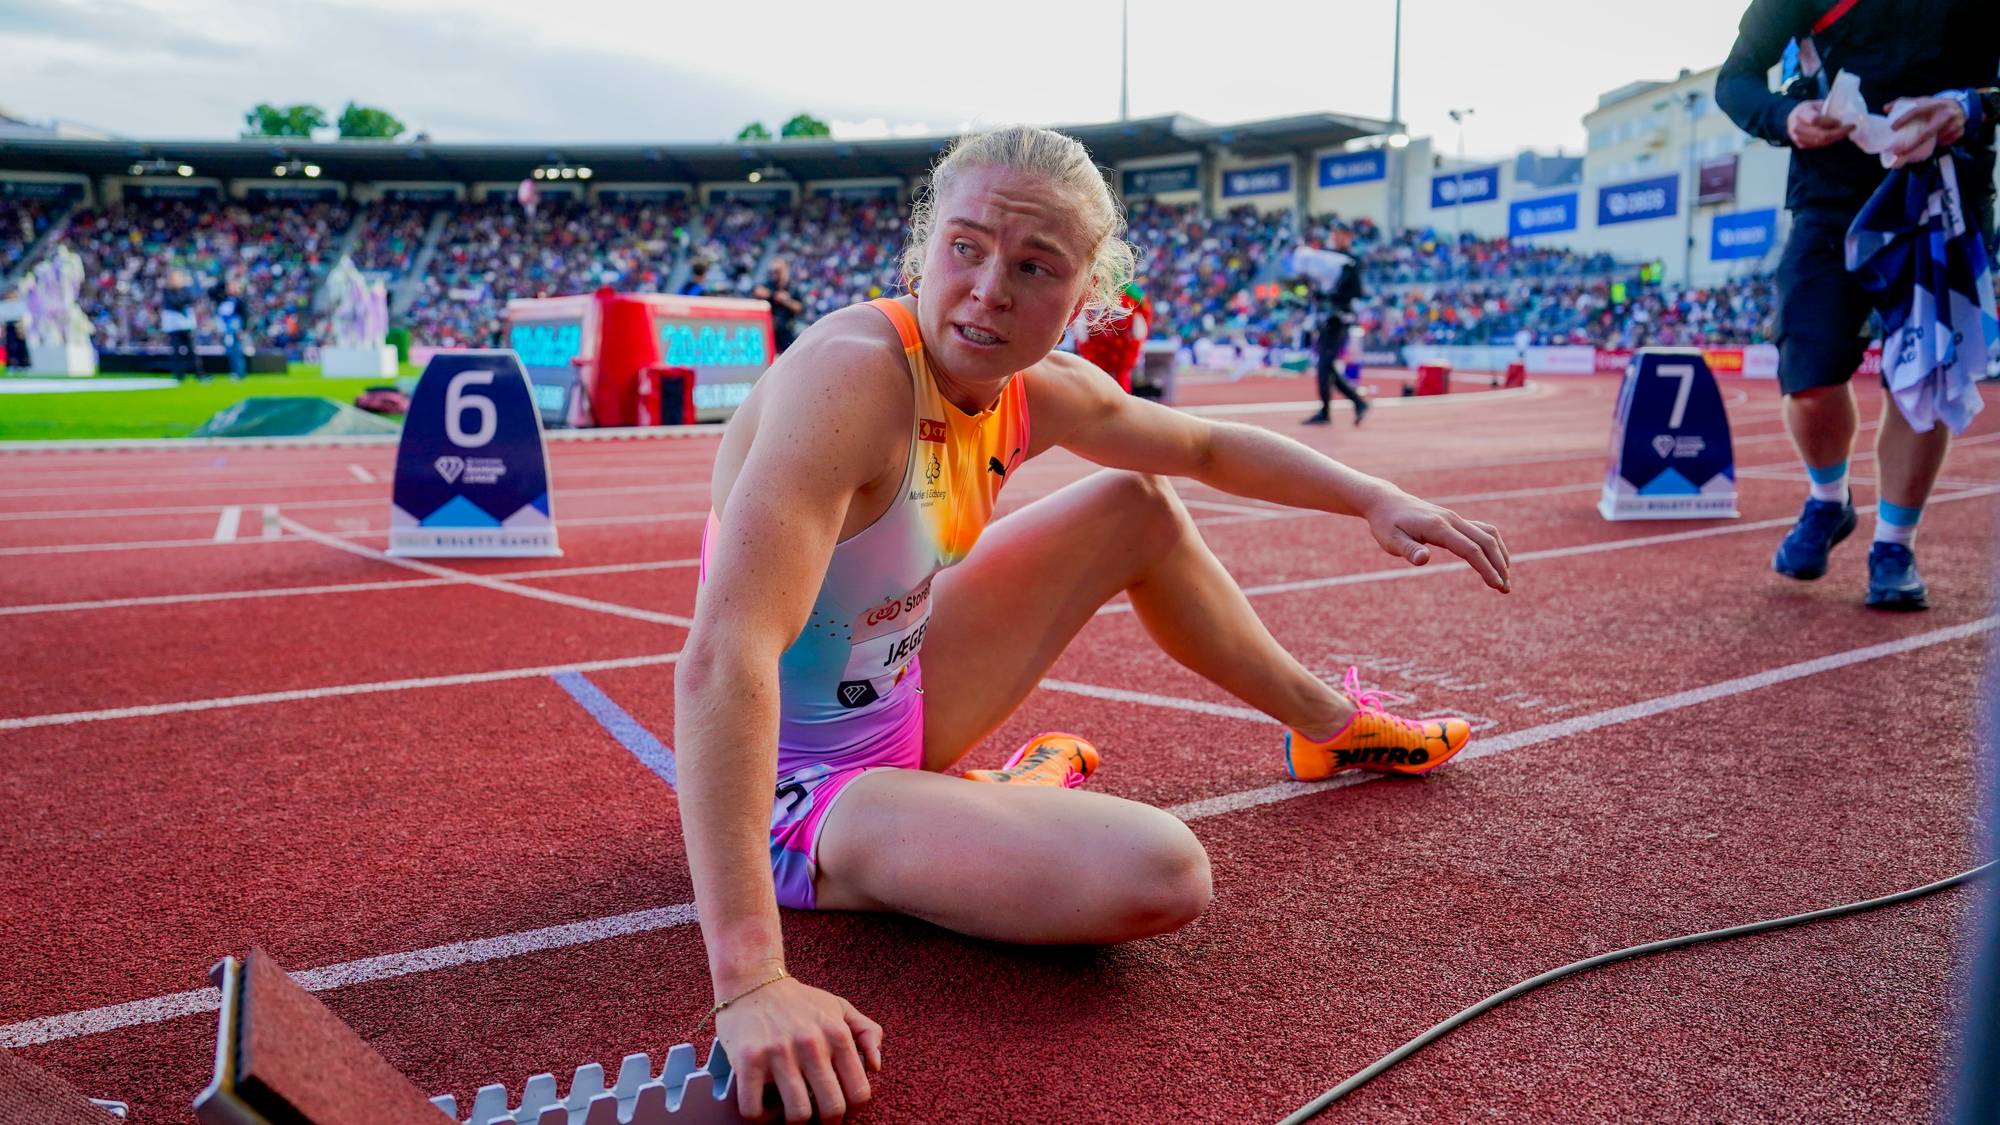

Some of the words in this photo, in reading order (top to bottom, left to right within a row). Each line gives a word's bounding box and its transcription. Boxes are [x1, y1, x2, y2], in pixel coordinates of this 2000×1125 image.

[445, 370, 498, 448] 6
[1656, 364, 1695, 428] 7
[884, 616, 930, 667] JÆGE
[1329, 747, 1430, 768] NITRO
[775, 776, 808, 813] 5
